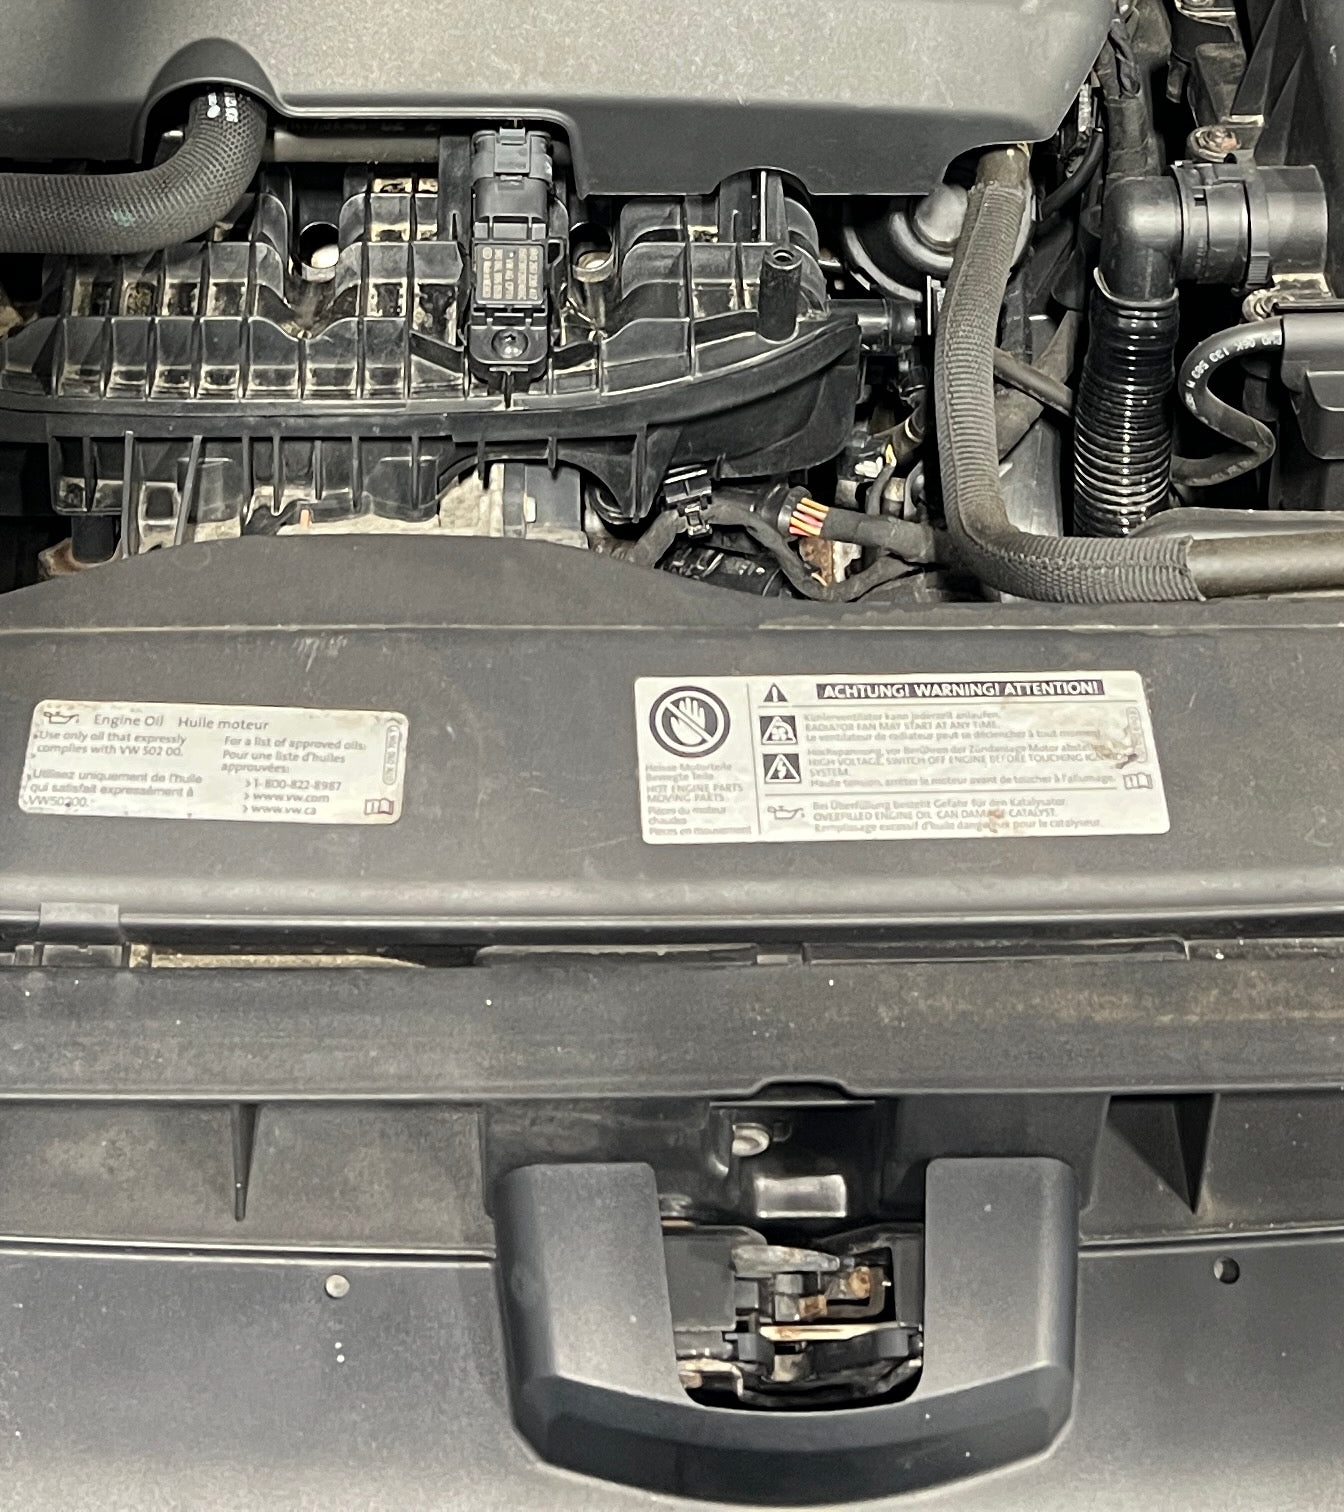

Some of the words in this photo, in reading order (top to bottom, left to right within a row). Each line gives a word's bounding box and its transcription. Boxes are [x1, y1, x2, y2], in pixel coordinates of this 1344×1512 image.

[823, 685, 911, 698] ACHTUNG!
[914, 683, 1000, 697] WARNING!
[1004, 681, 1099, 696] ATTENTION!
[94, 714, 141, 728] Engine
[144, 715, 164, 727] Oil
[178, 716, 214, 729] Huile
[218, 721, 269, 730] moteur
[39, 730, 60, 740] Use
[63, 732, 88, 742] only
[107, 733, 130, 742] that
[134, 734, 187, 746] expressly
[289, 739, 341, 751] approved
[37, 745, 87, 755] complies
[91, 745, 116, 754] with
[120, 746, 140, 755] VW
[143, 747, 163, 756] 502
